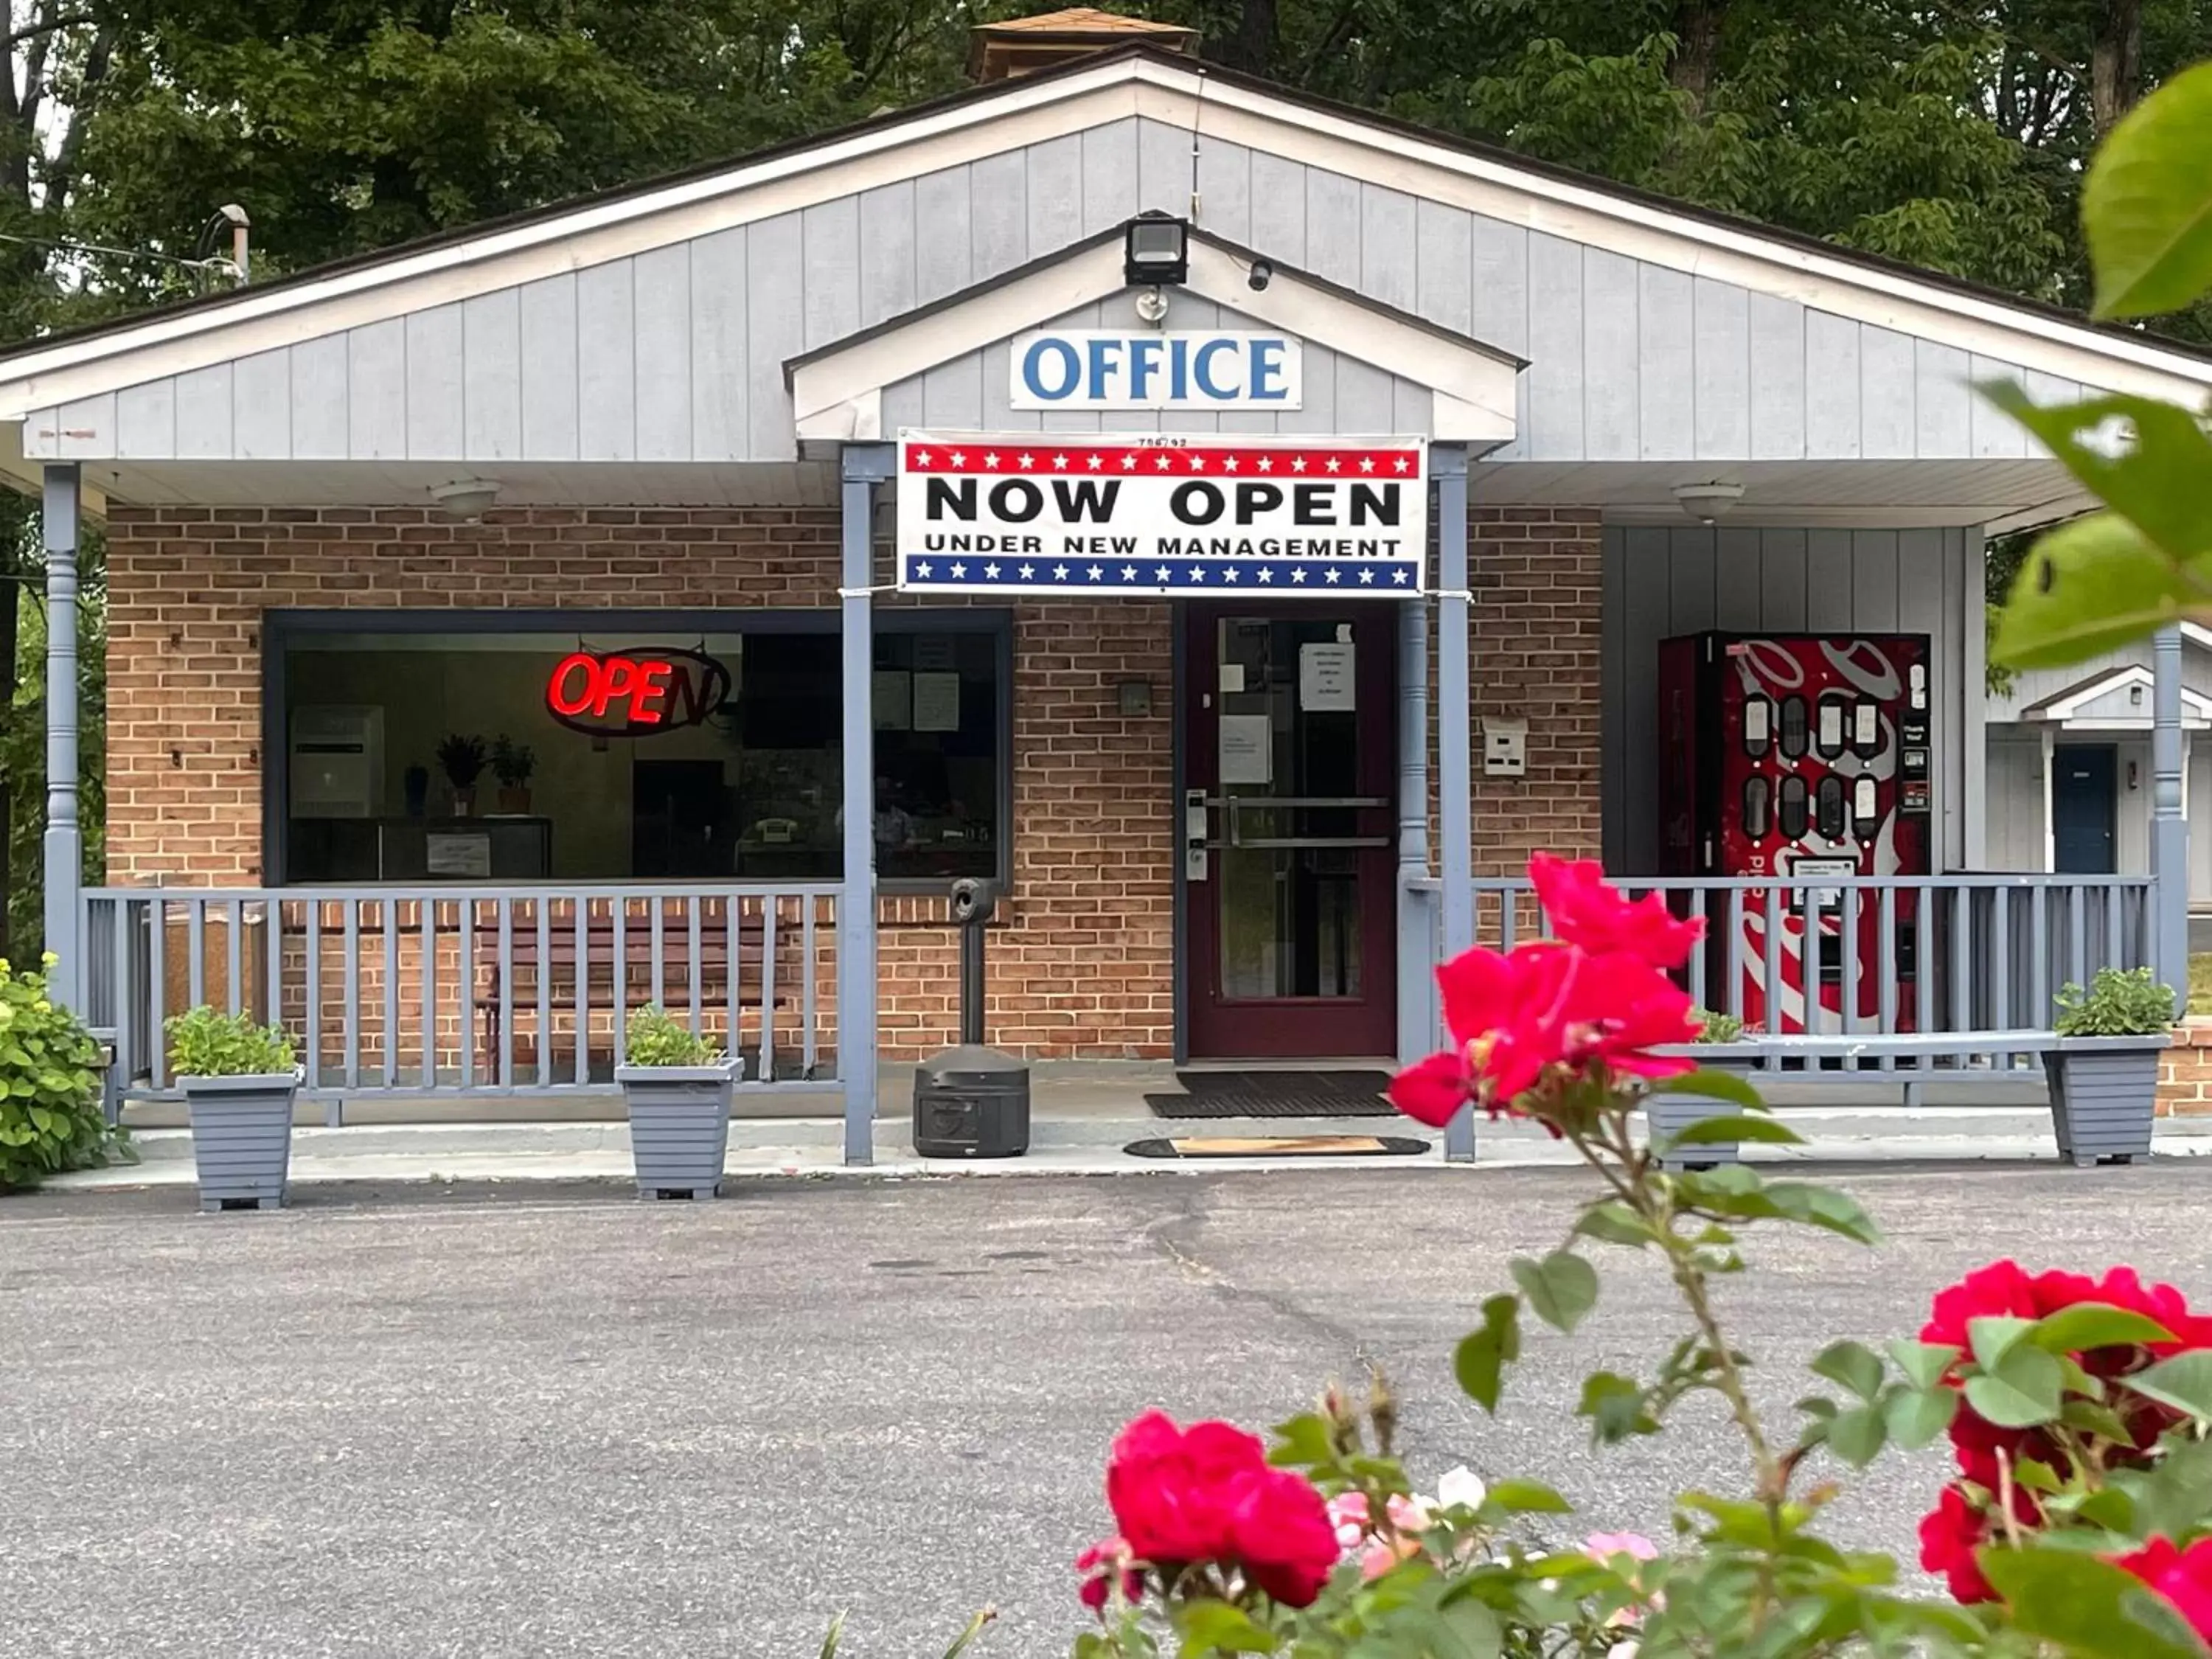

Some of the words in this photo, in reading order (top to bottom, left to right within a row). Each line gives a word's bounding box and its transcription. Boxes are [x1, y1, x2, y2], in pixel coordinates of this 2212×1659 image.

[1022, 338, 1289, 400] OFFICE
[926, 478, 1121, 523] NOW
[1169, 481, 1401, 526] OPEN
[925, 534, 1041, 553] UNDER
[1064, 537, 1137, 554] NEW
[1158, 538, 1401, 557] MANAGEMENT
[547, 652, 716, 727] OPEN
